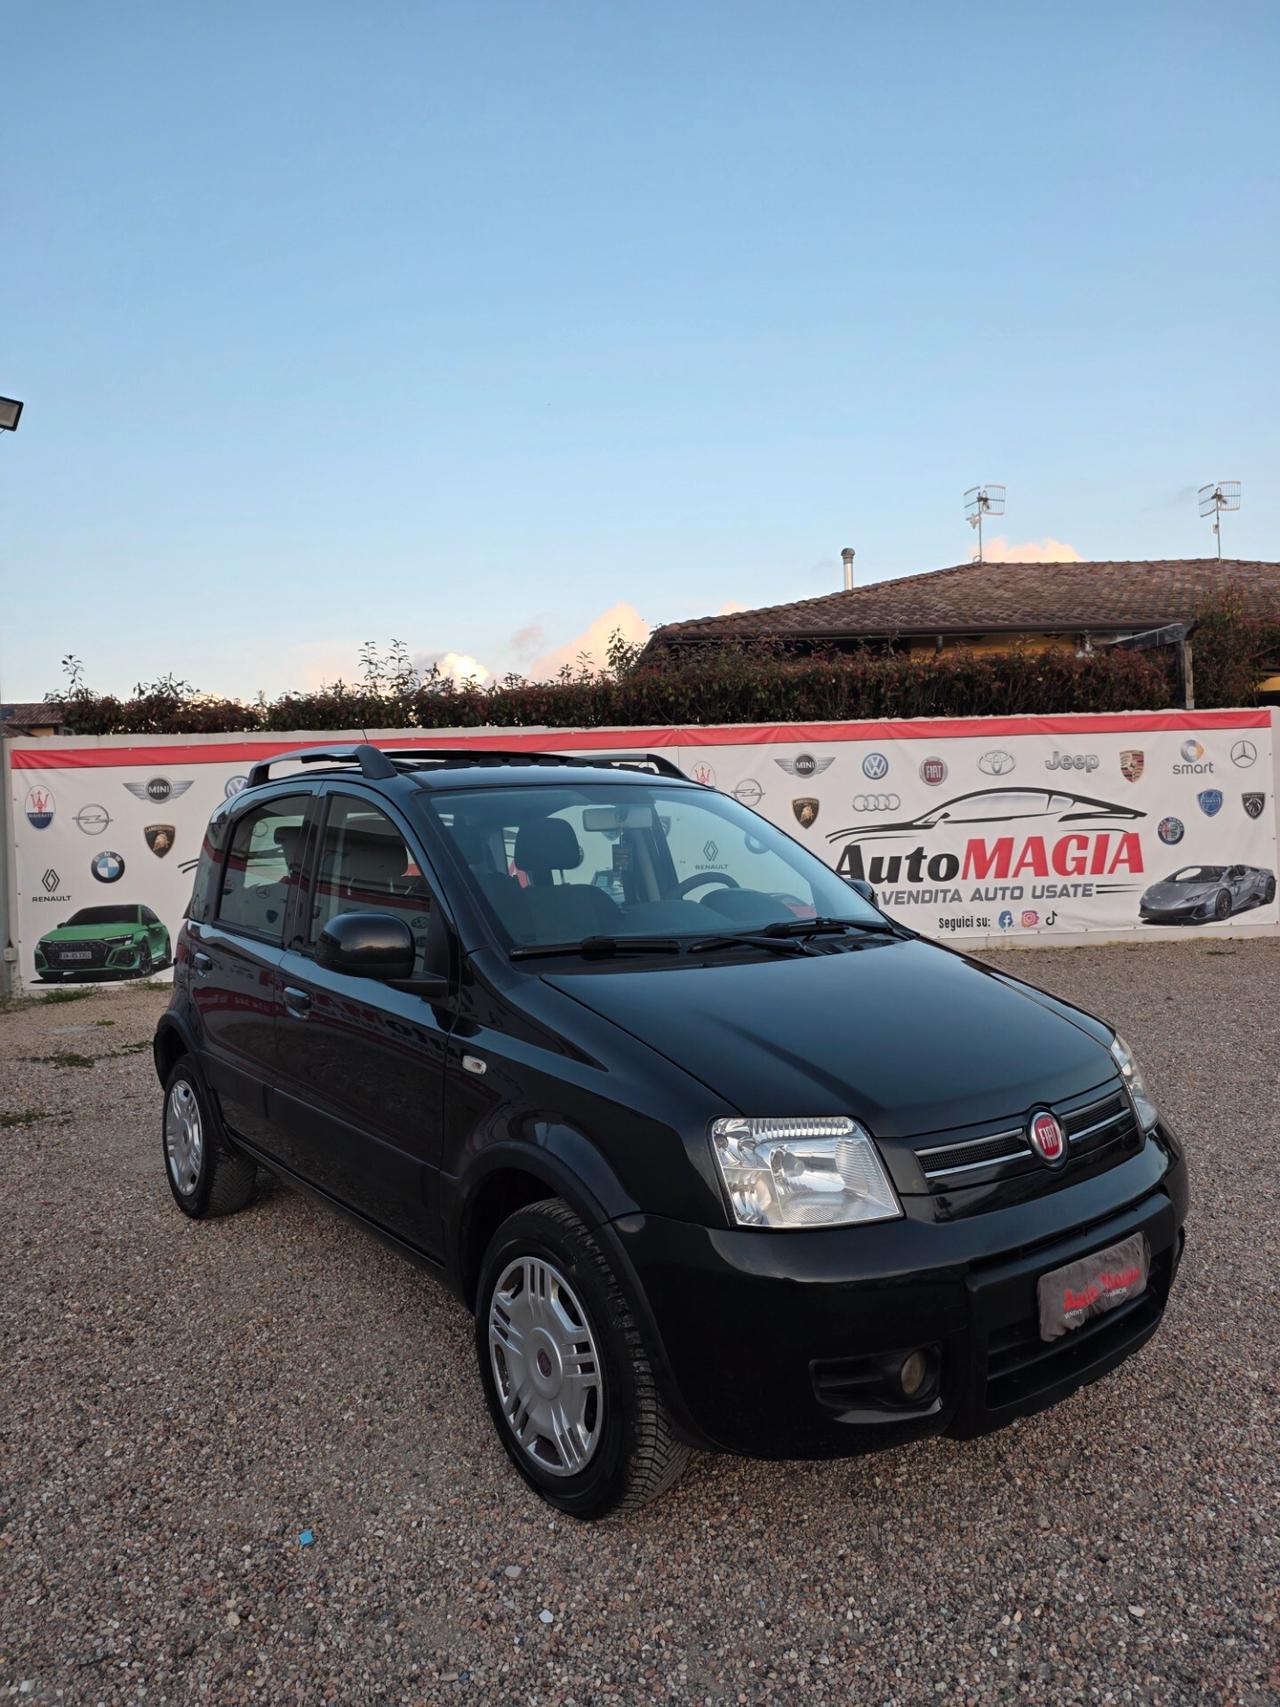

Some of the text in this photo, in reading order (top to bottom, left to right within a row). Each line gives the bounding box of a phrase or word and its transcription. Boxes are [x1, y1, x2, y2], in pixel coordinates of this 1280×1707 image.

[796, 761, 815, 769] MINI
[1045, 751, 1100, 773] Jeep
[1173, 762, 1214, 775] smart
[925, 765, 942, 779] FIAT
[148, 785, 170, 794] MINI
[882, 883, 1093, 905] VENDITA AUTO USATE
[939, 916, 991, 931] Seguici su:
[1038, 1124, 1058, 1149] FIAT
